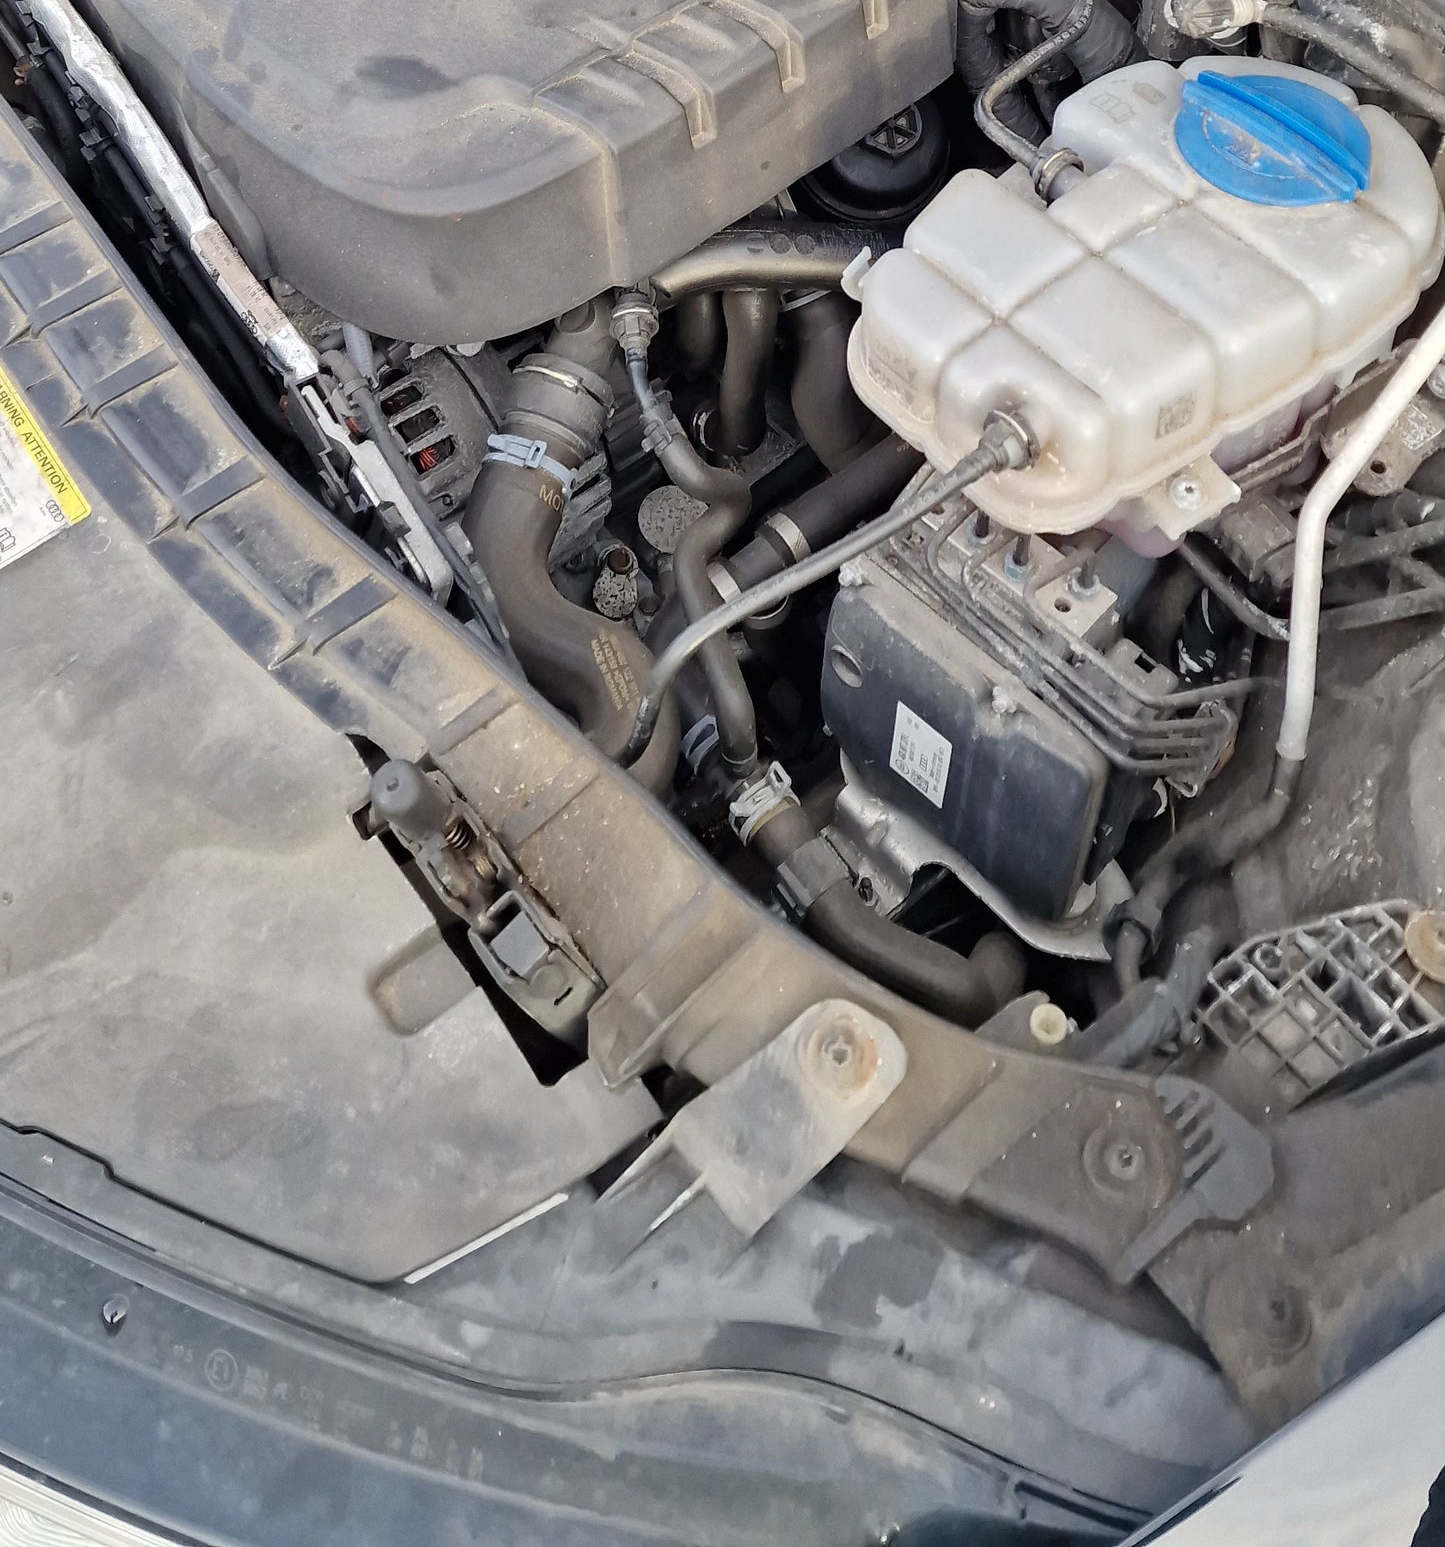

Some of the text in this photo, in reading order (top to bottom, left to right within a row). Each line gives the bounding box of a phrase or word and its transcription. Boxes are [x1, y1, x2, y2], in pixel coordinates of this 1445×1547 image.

[22, 432, 68, 494] ATTENTION
[591, 639, 605, 665] MADE
[599, 663, 609, 674] IN
